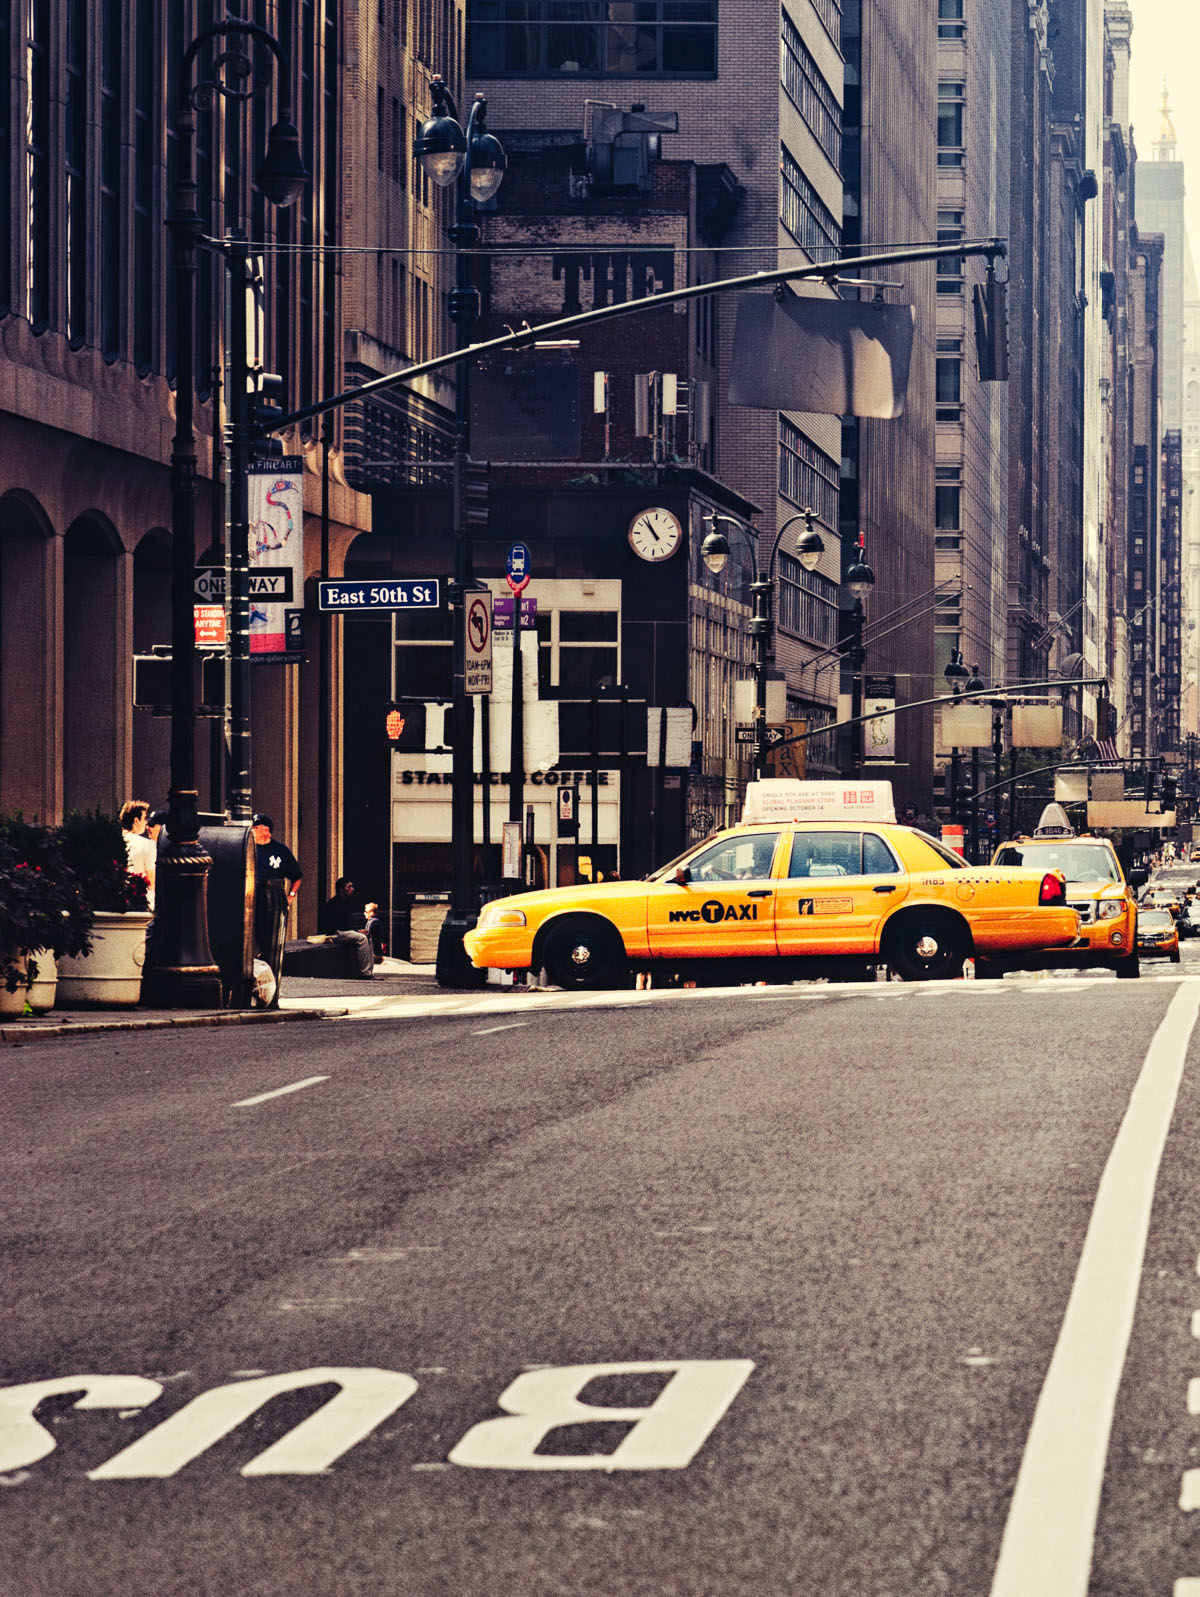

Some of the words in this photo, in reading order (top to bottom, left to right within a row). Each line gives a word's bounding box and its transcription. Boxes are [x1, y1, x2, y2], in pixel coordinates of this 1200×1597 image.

[327, 588, 366, 606] East
[370, 586, 408, 604] 50th
[412, 586, 432, 603] St
[669, 911, 700, 923] NYC
[702, 900, 757, 923] TAXI
[0, 1359, 757, 1480] BUS
